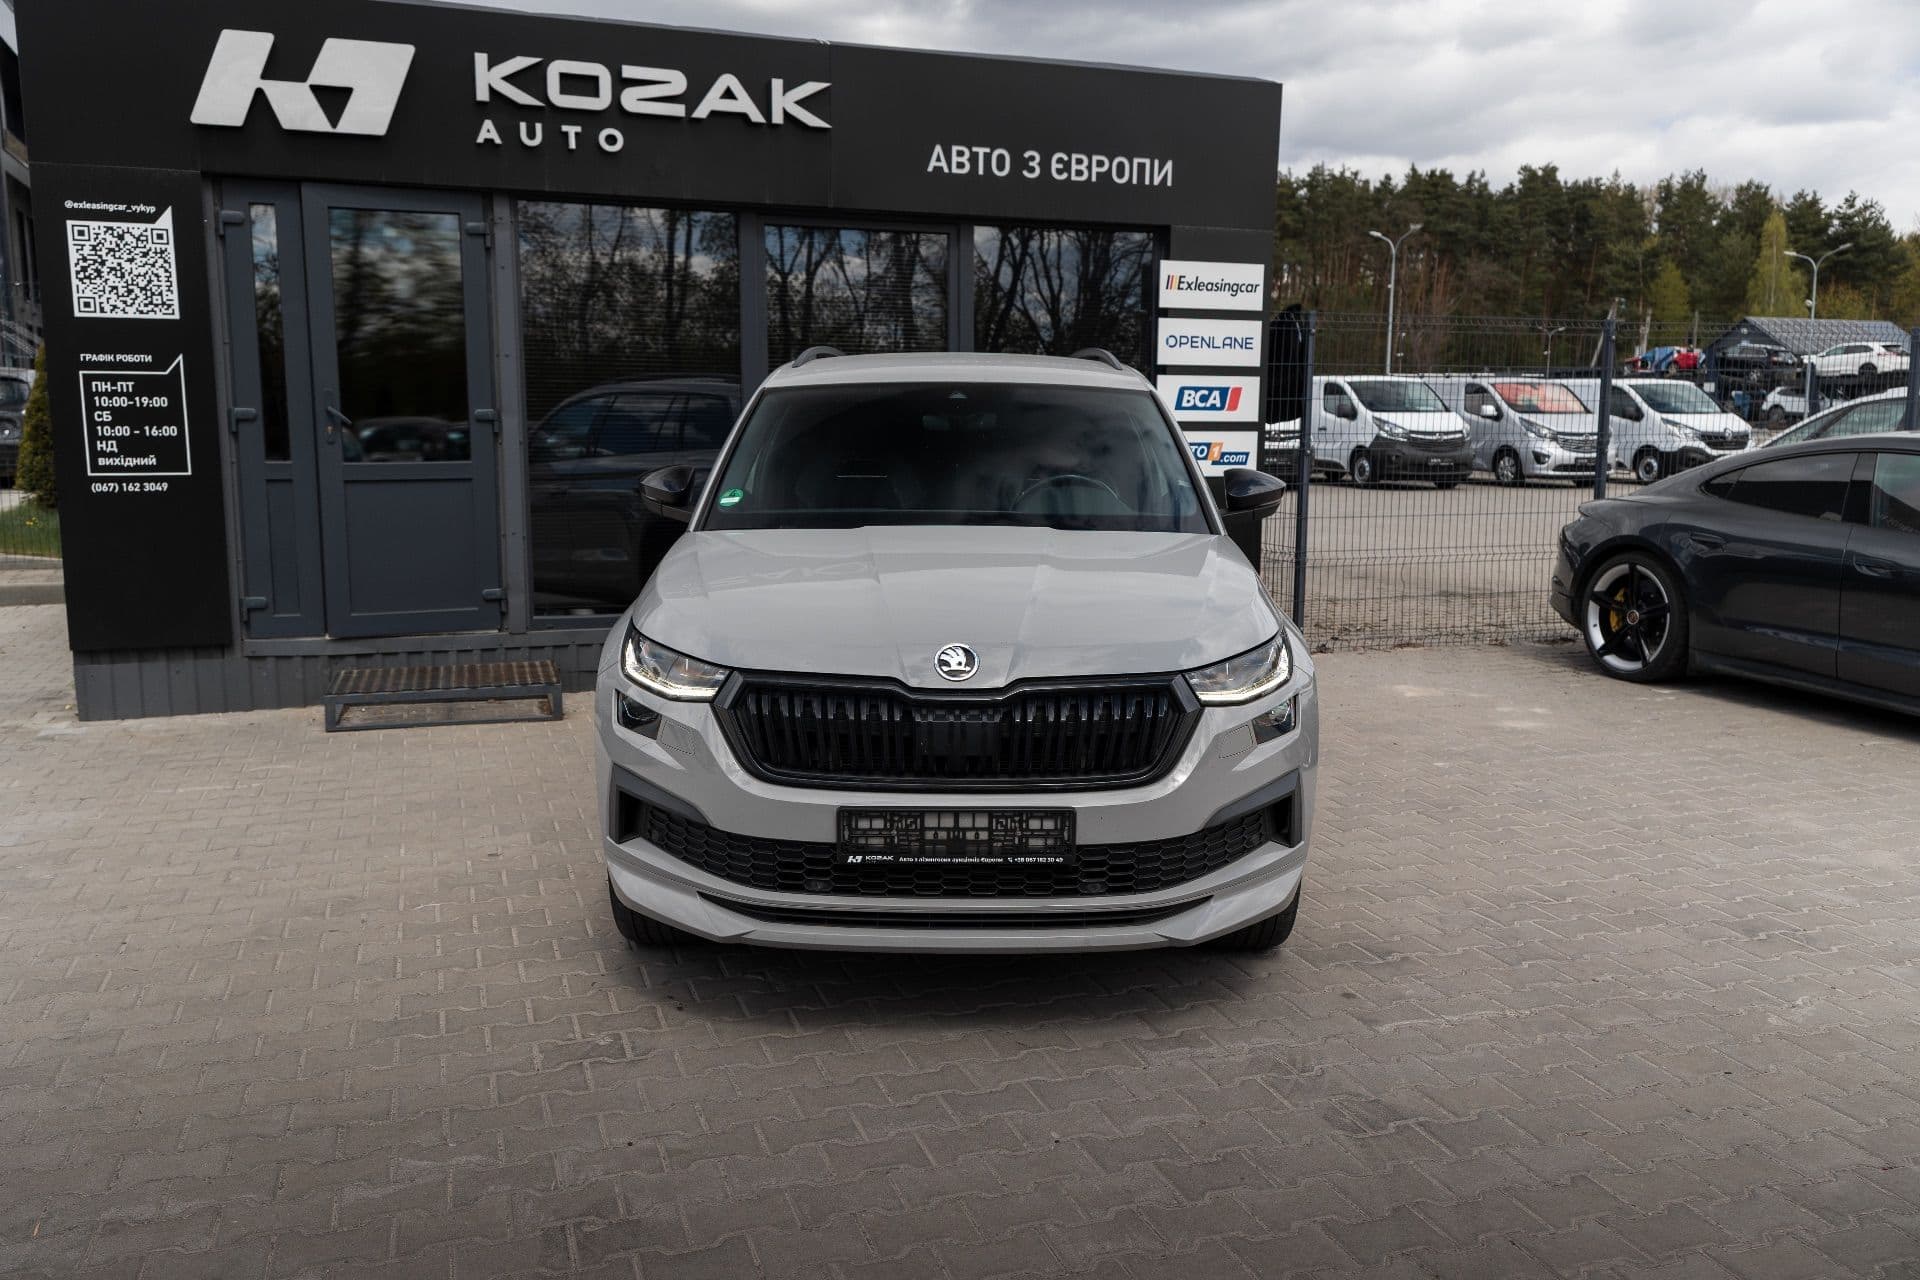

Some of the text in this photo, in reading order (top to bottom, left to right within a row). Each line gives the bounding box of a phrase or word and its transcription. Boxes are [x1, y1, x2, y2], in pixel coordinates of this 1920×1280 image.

[474, 52, 832, 129] KOZAK
[476, 119, 625, 152] AUTO
[927, 144, 1173, 187] АВТО З ЄВРОПИ
[64, 200, 156, 213] @exleasingcar_vykyp
[1177, 275, 1260, 297] Exleasingcar
[1165, 335, 1254, 350] OPENLANE
[80, 353, 152, 363] ГРАФІК РОБОТИ
[91, 381, 135, 392] ПН-ПТ
[94, 396, 168, 407] 10:00-19:00
[1182, 389, 1221, 408] BCA
[94, 411, 112, 421] СБ
[97, 425, 130, 436] 10:00
[144, 425, 177, 436] 16:00
[96, 440, 118, 453] НД
[98, 455, 156, 467] вихідний
[91, 482, 168, 493] (067) 162 3049
